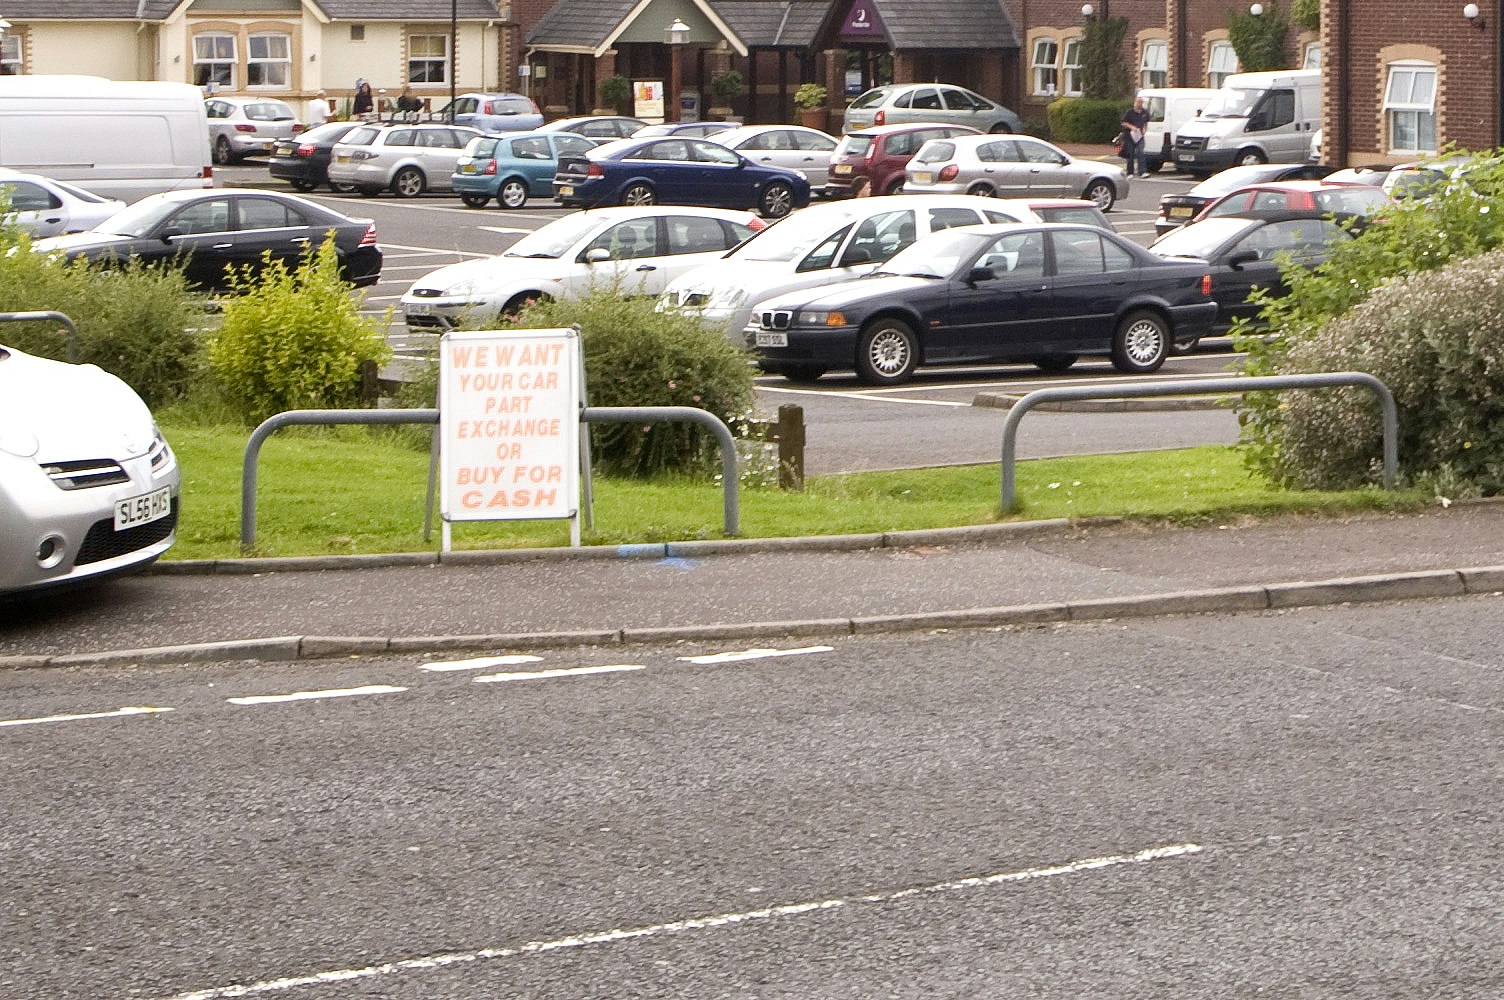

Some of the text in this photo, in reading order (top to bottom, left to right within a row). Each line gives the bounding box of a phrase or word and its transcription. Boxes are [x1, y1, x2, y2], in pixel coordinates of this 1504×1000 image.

[452, 344, 564, 368] WE WANT
[459, 372, 559, 392] YOUR CAR
[485, 396, 534, 414] PART
[457, 418, 561, 439] EXCHANGE
[496, 442, 522, 460] OR
[456, 465, 562, 485] BUY FOR
[462, 489, 558, 509] CASH
[120, 497, 151, 524] SL56
